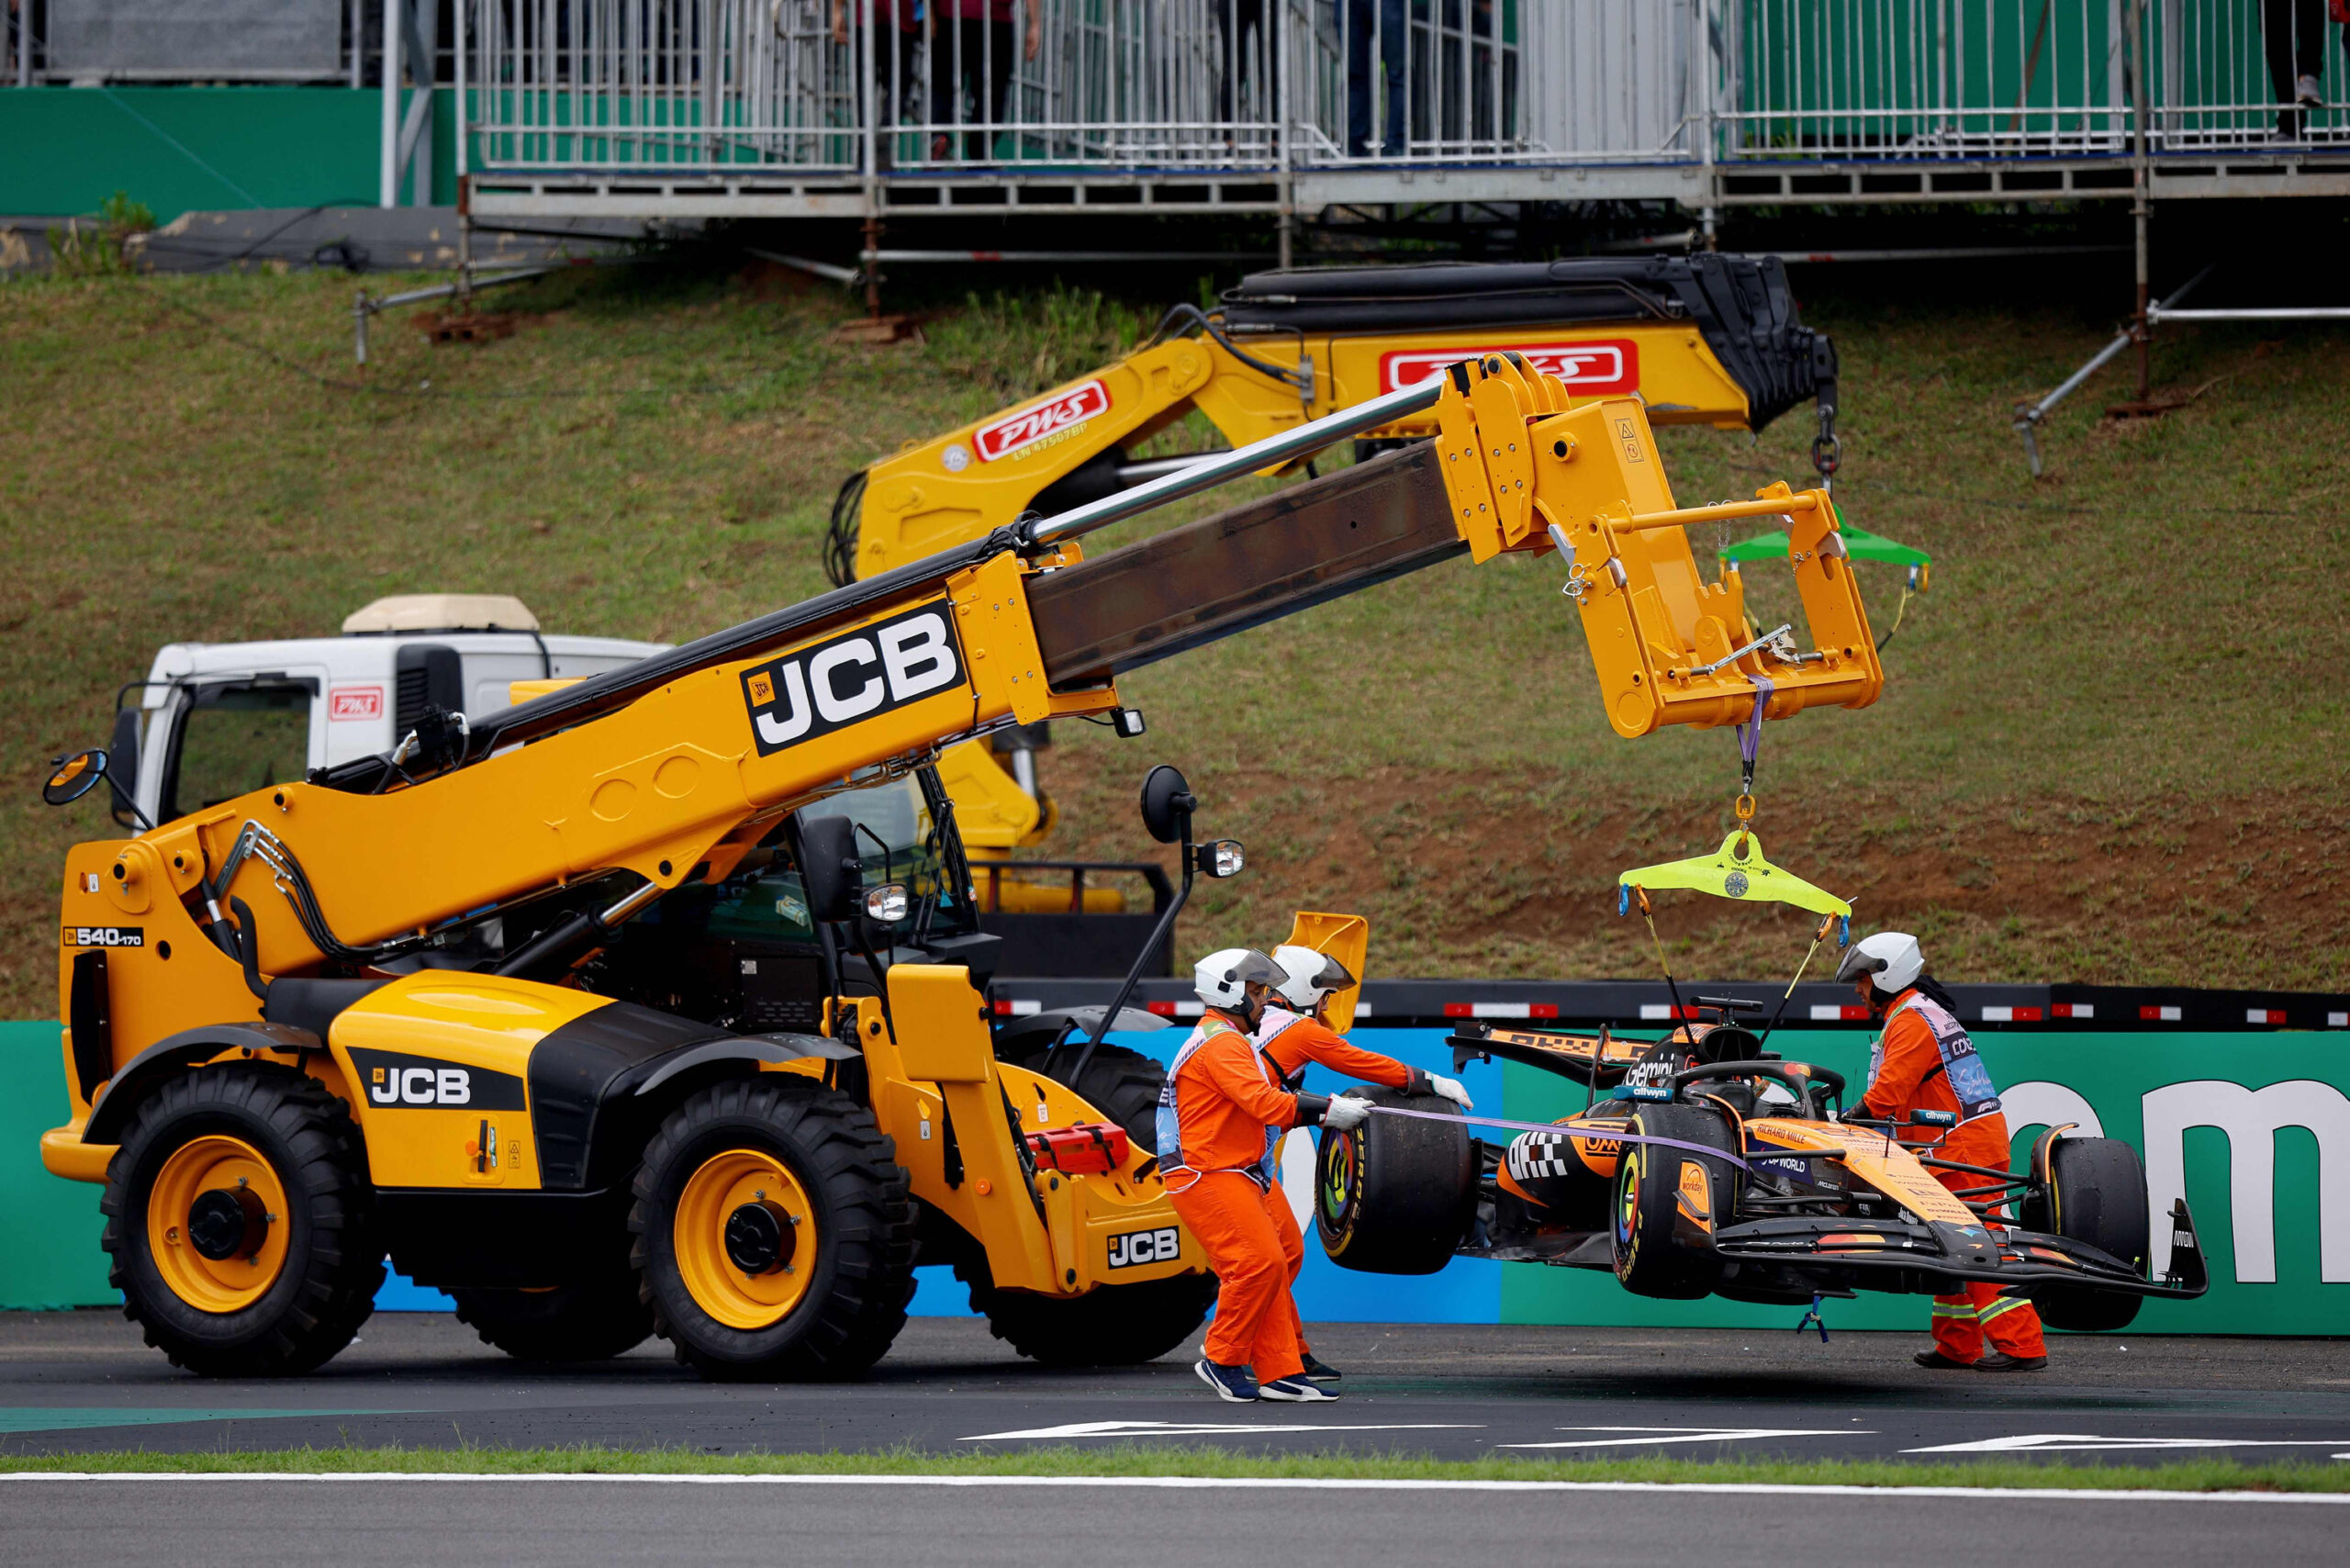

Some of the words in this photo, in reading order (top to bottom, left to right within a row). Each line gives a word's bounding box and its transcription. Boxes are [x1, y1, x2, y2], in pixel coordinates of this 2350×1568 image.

[998, 393, 1090, 451] PWS
[755, 612, 957, 745] JCB
[1625, 1052, 1675, 1087] Gemini
[372, 1068, 471, 1104] JCB
[1633, 1087, 1667, 1099] allwyn
[1925, 1111, 1952, 1123] allwyn
[1757, 1123, 1786, 1139] RICHARD
[1786, 1131, 1807, 1144] MILLE
[1779, 1158, 1806, 1173] WORLD
[1682, 1181, 1704, 1193] workday
[1109, 1228, 1179, 1267] JCB
